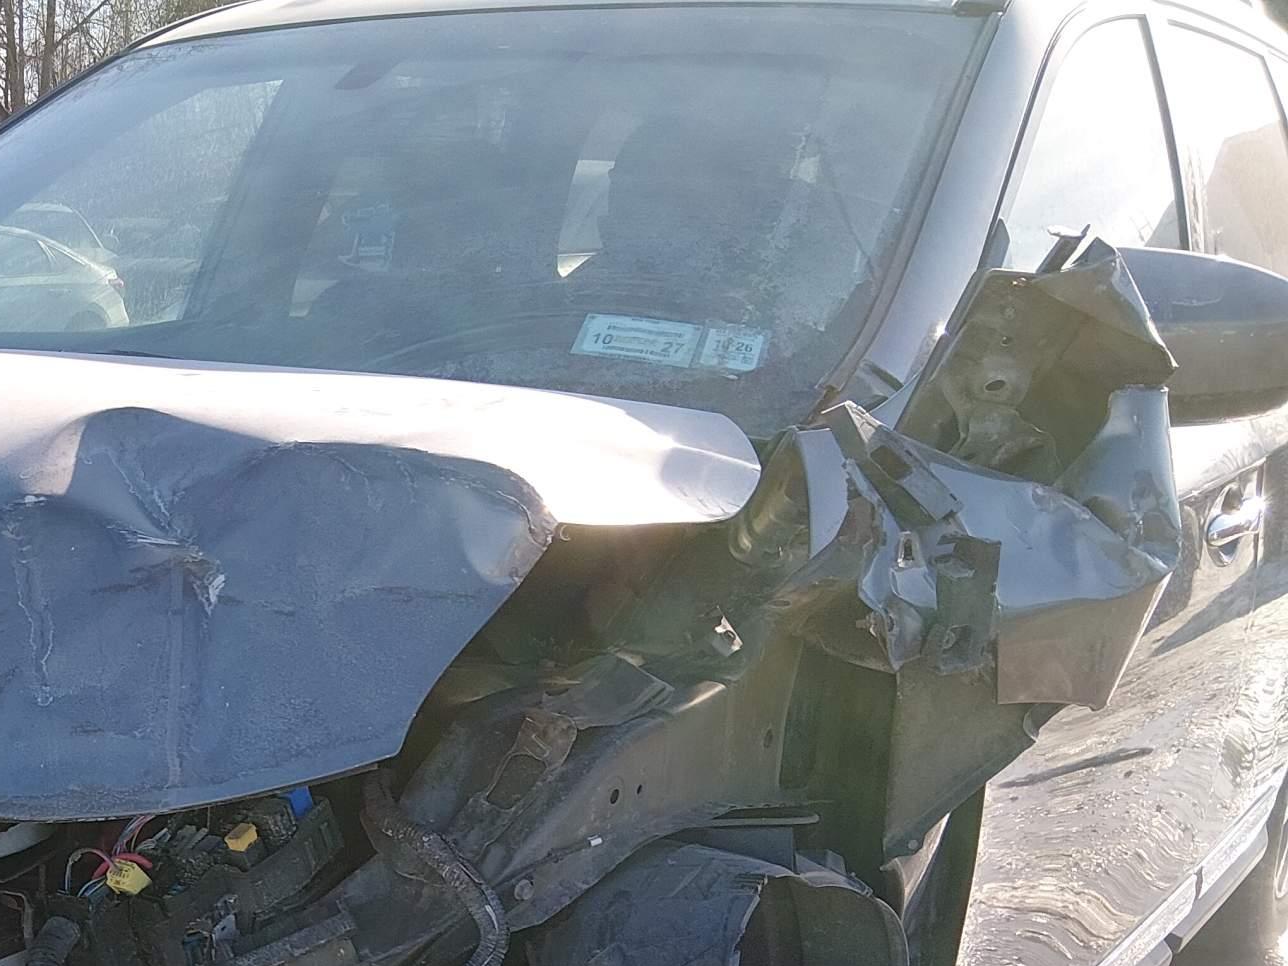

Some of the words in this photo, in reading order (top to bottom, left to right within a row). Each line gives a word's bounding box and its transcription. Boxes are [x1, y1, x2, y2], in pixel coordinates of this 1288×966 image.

[592, 332, 614, 345] 10
[660, 341, 685, 354] 27
[735, 341, 753, 353] 26
